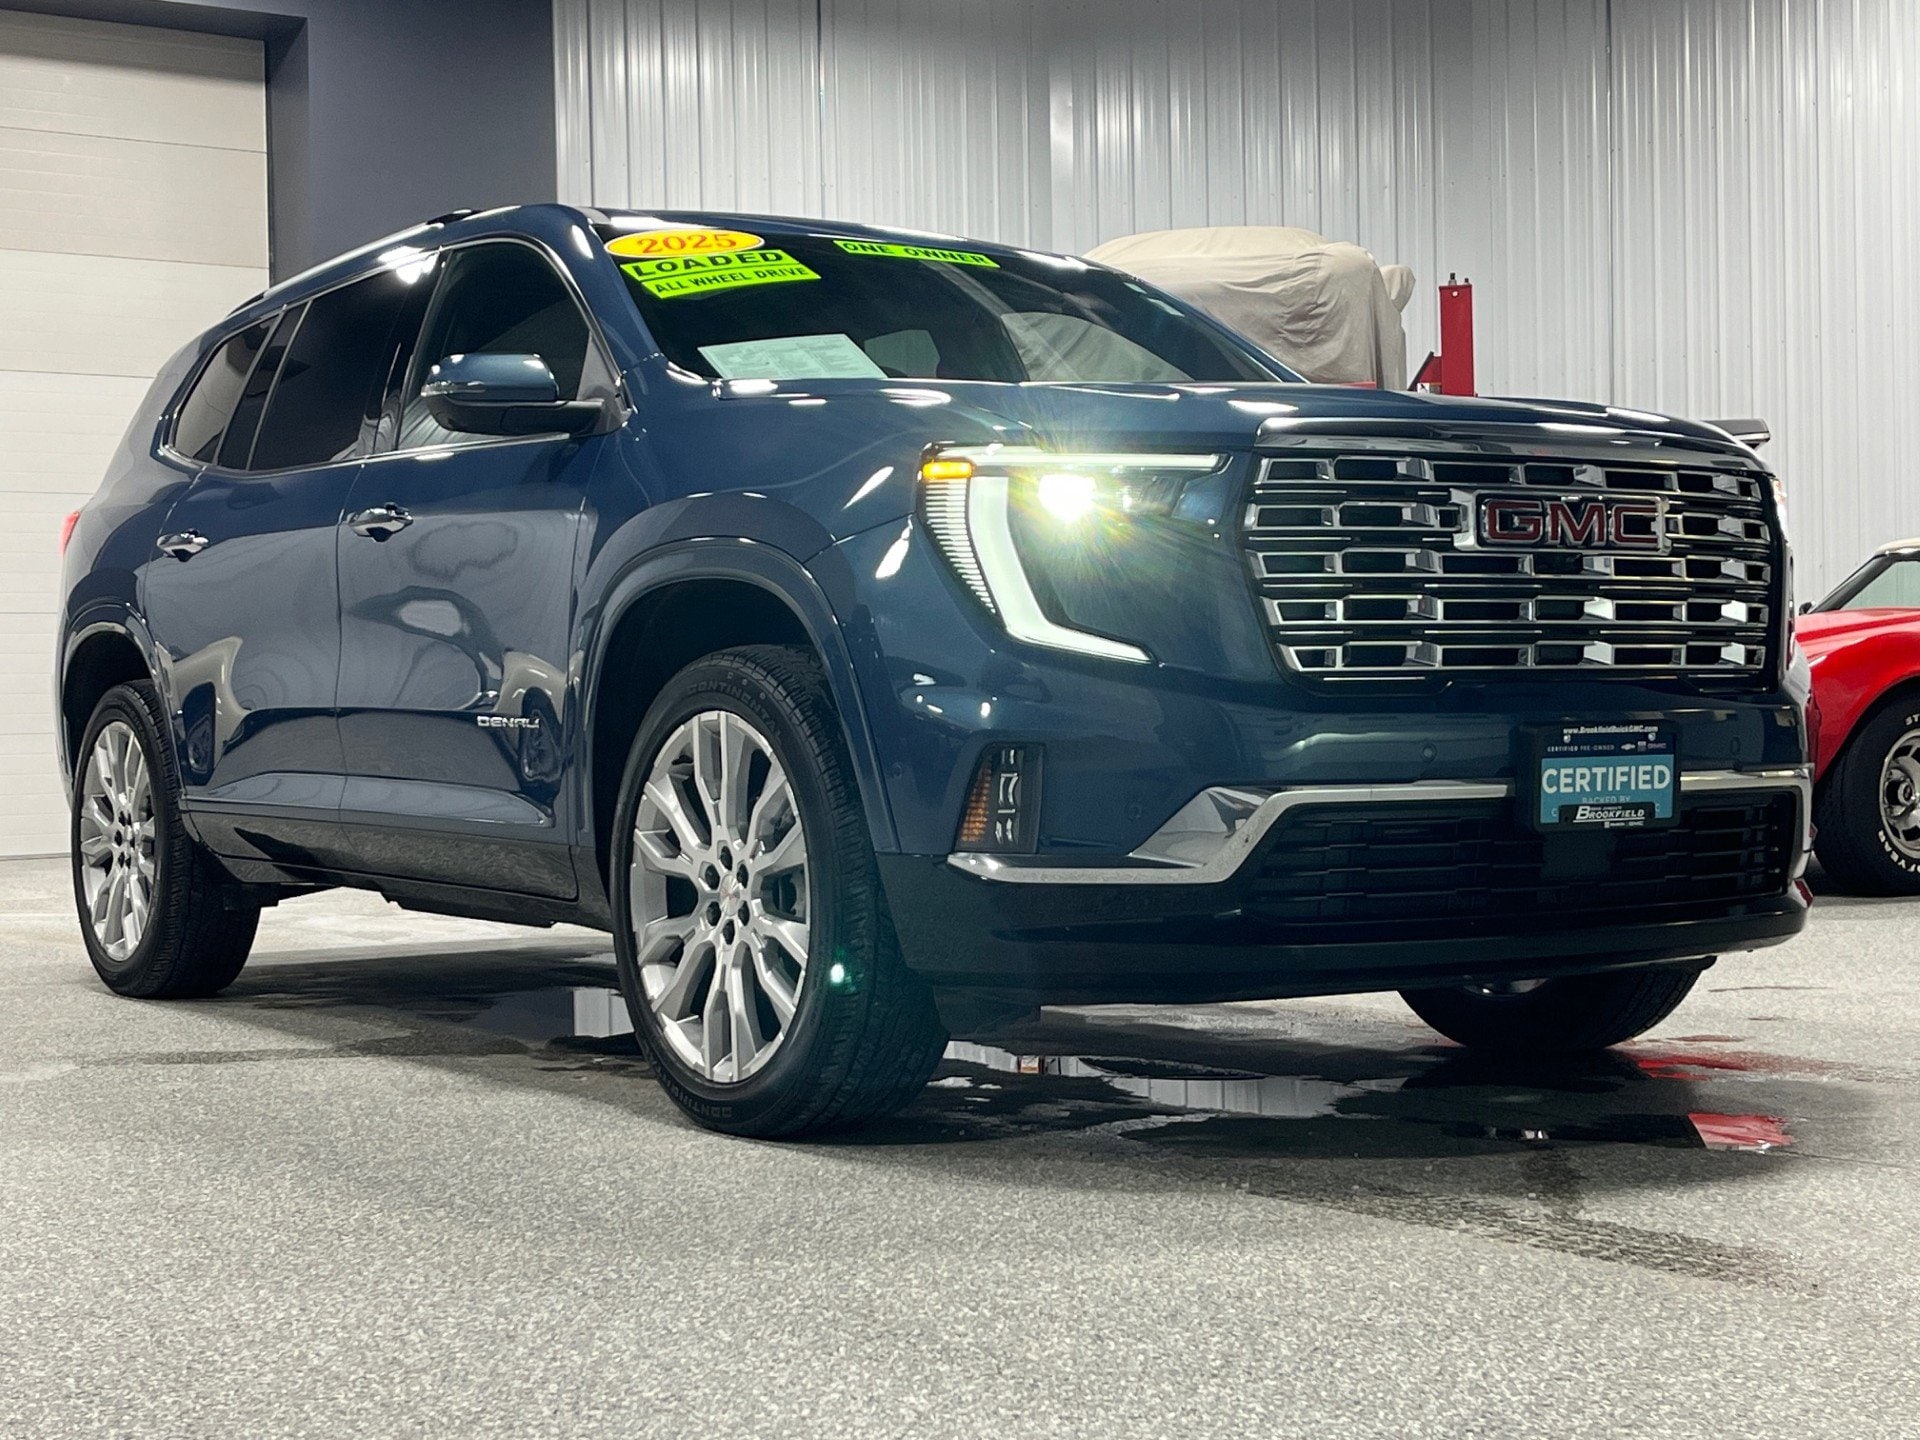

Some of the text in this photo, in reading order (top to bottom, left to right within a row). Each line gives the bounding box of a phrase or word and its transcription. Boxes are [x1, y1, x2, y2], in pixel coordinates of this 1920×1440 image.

[637, 234, 737, 254] 2025
[843, 242, 988, 264] ONE OWNER
[632, 250, 784, 277] LOADED
[655, 267, 810, 293] ALL WHEEL DRIVE
[1483, 499, 1658, 547] GMC
[477, 715, 540, 728] DENALI
[1541, 764, 1671, 794] CERTIFIED
